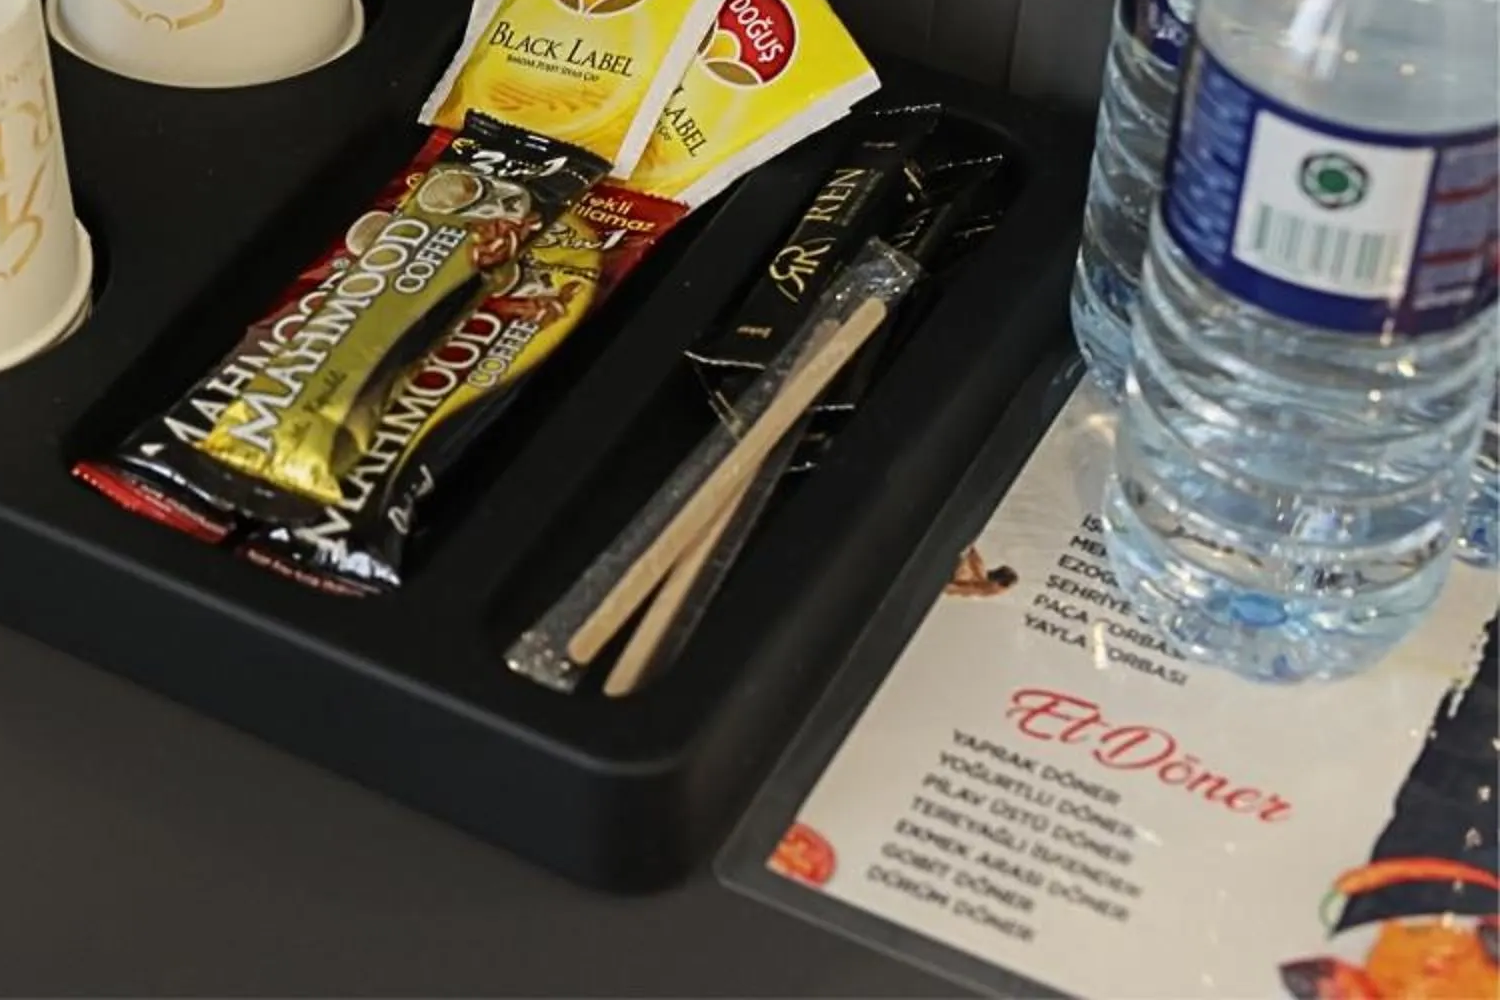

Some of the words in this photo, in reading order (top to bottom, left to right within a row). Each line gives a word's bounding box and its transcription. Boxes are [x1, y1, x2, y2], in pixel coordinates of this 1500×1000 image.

[489, 21, 564, 59] BLACK
[565, 37, 635, 77] LABEL
[802, 168, 867, 222] REN
[394, 226, 466, 293] COFFEE
[228, 218, 429, 454] MAHMOOD
[467, 318, 539, 389] COFFEE
[292, 310, 502, 546] MAHMOOD
[1057, 553, 1119, 588] EZOG
[1024, 613, 1087, 648] YAYLA
[1102, 646, 1189, 686] ORBASI
[953, 729, 1038, 774] YAPRAK
[1040, 764, 1122, 806] DÖNER
[1006, 689, 1108, 742] Et
[1092, 726, 1291, 822] Döner
[1052, 824, 1133, 865] DÖNER
[1056, 799, 1136, 840] DÖNER
[952, 870, 1035, 912] DÖNER
[1047, 880, 1130, 922] DÖNER
[952, 900, 1035, 942] DÖNER
